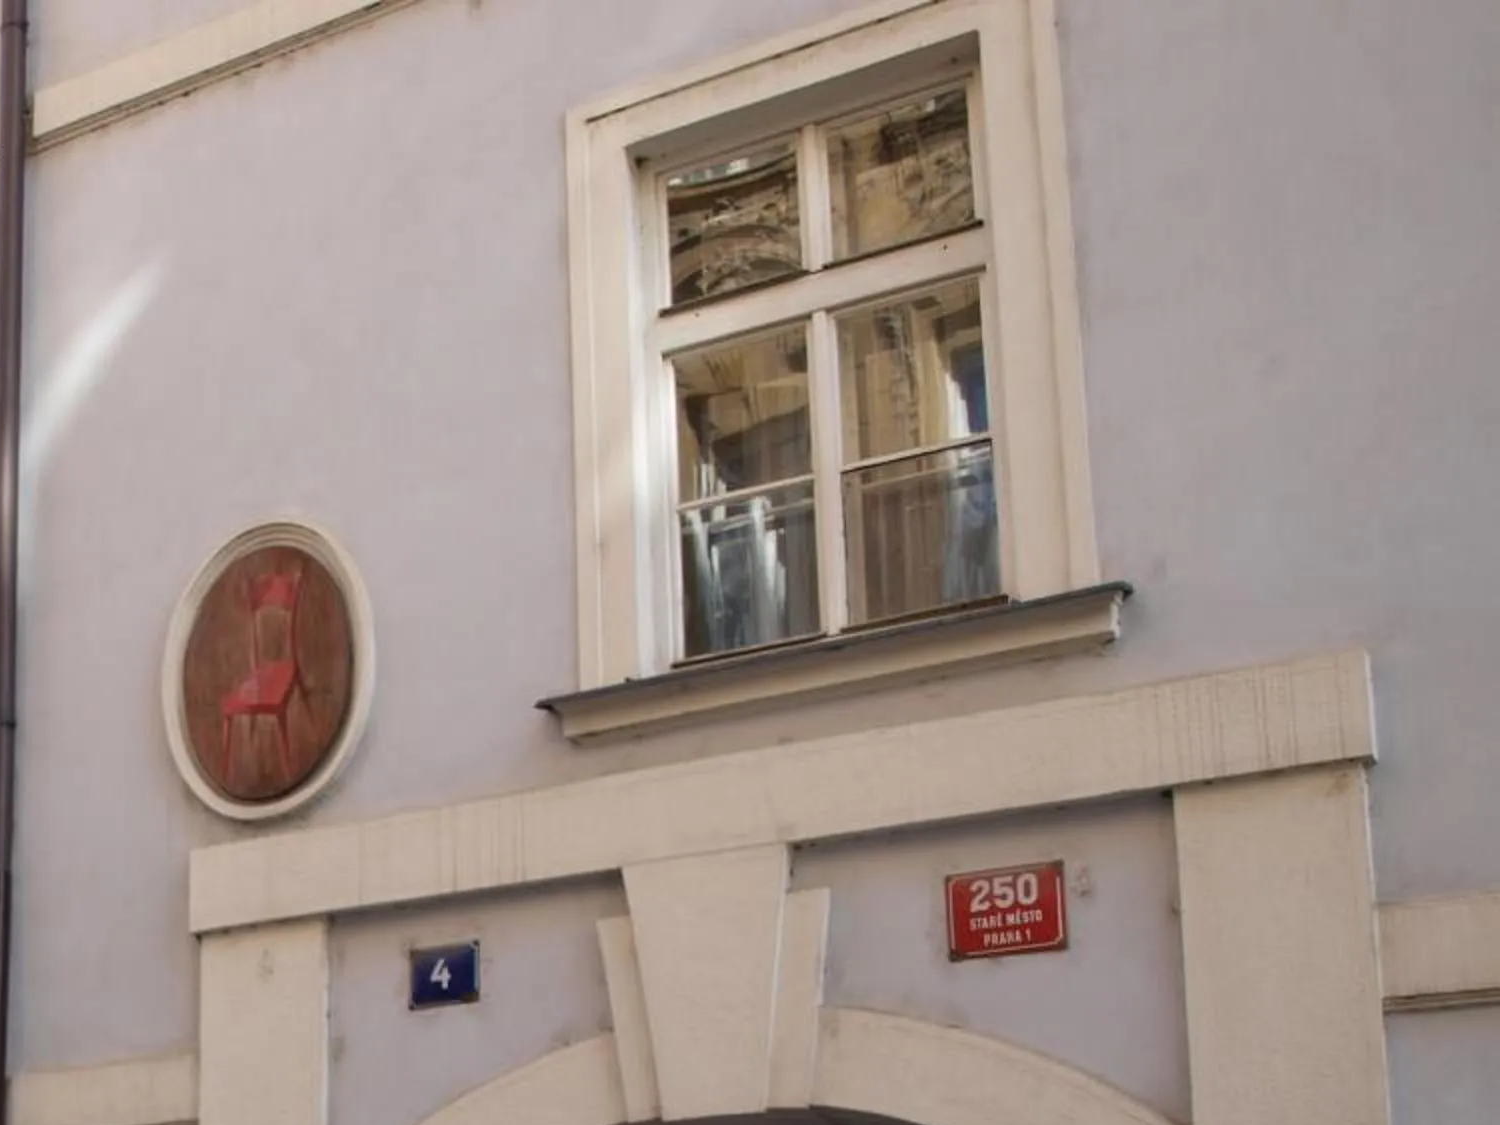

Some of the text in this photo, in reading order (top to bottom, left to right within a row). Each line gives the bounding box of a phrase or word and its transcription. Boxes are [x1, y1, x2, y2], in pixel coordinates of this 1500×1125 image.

[969, 873, 1039, 913] 250
[983, 927, 1032, 948] PRAHA 1
[430, 959, 452, 990] 4
